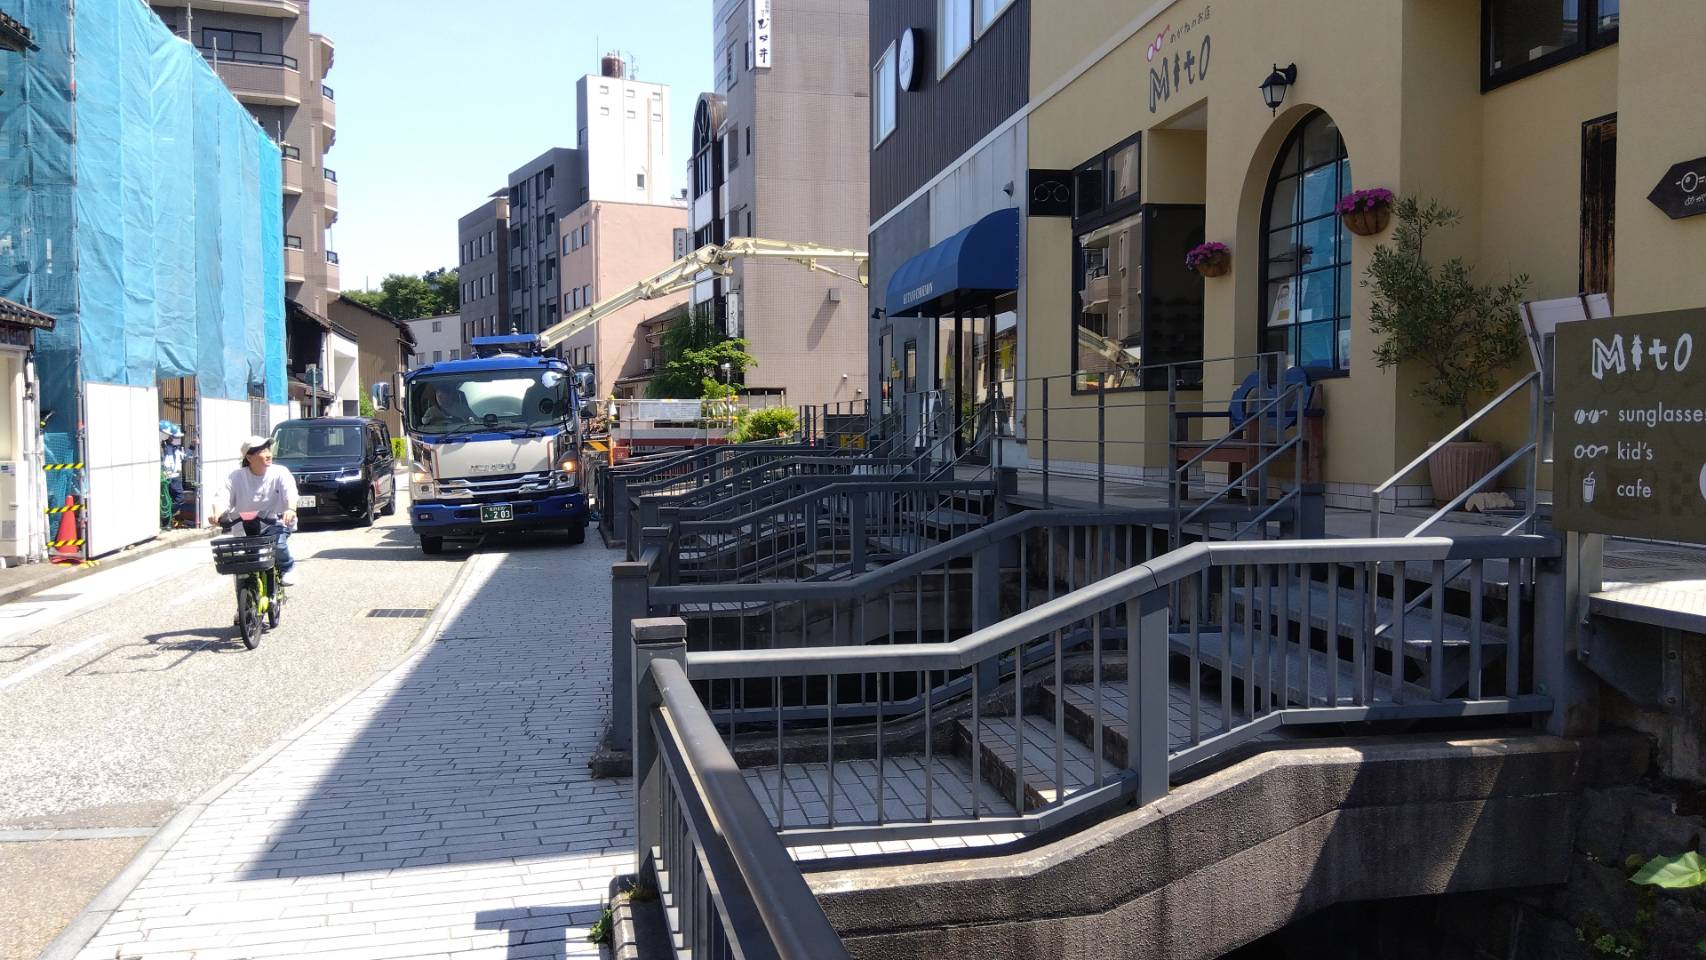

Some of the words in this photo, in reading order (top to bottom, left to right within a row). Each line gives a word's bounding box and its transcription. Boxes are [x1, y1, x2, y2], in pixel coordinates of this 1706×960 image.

[1617, 401, 1706, 428] sunglasse
[1617, 441, 1654, 461] kid's
[1616, 478, 1652, 498] cafe
